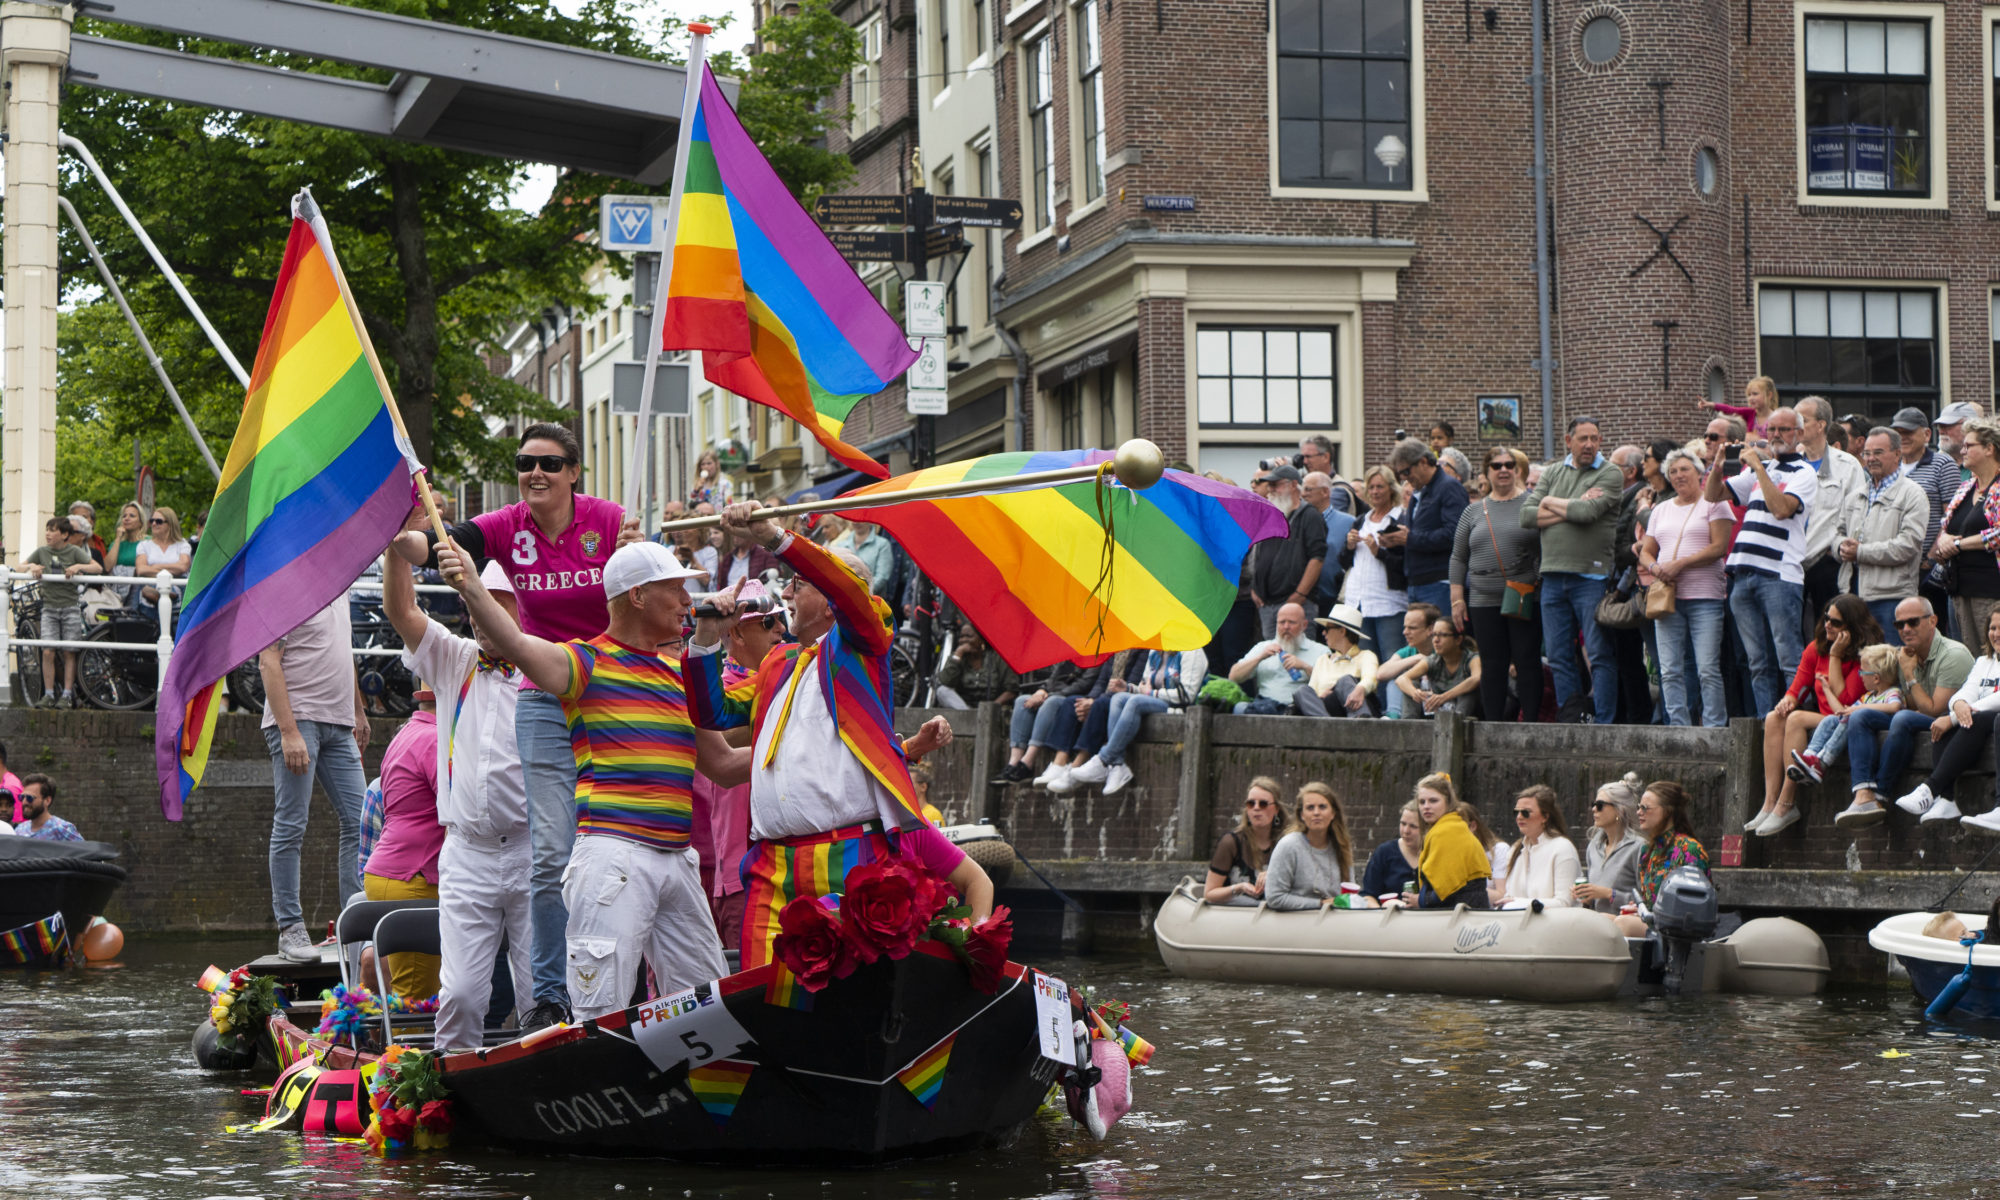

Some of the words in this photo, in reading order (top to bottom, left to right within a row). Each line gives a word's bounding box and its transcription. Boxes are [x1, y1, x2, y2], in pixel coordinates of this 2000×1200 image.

[1146, 198, 1194, 208] WAAGPLEIN
[858, 233, 876, 243] Stad
[855, 250, 892, 259] Turfmarkt
[511, 529, 538, 566] 3
[513, 567, 603, 591] GREECE
[1037, 977, 1069, 1004] PRIDE
[640, 996, 715, 1029] PRIDE
[679, 1030, 714, 1061] 5
[1052, 1016, 1060, 1055] 5
